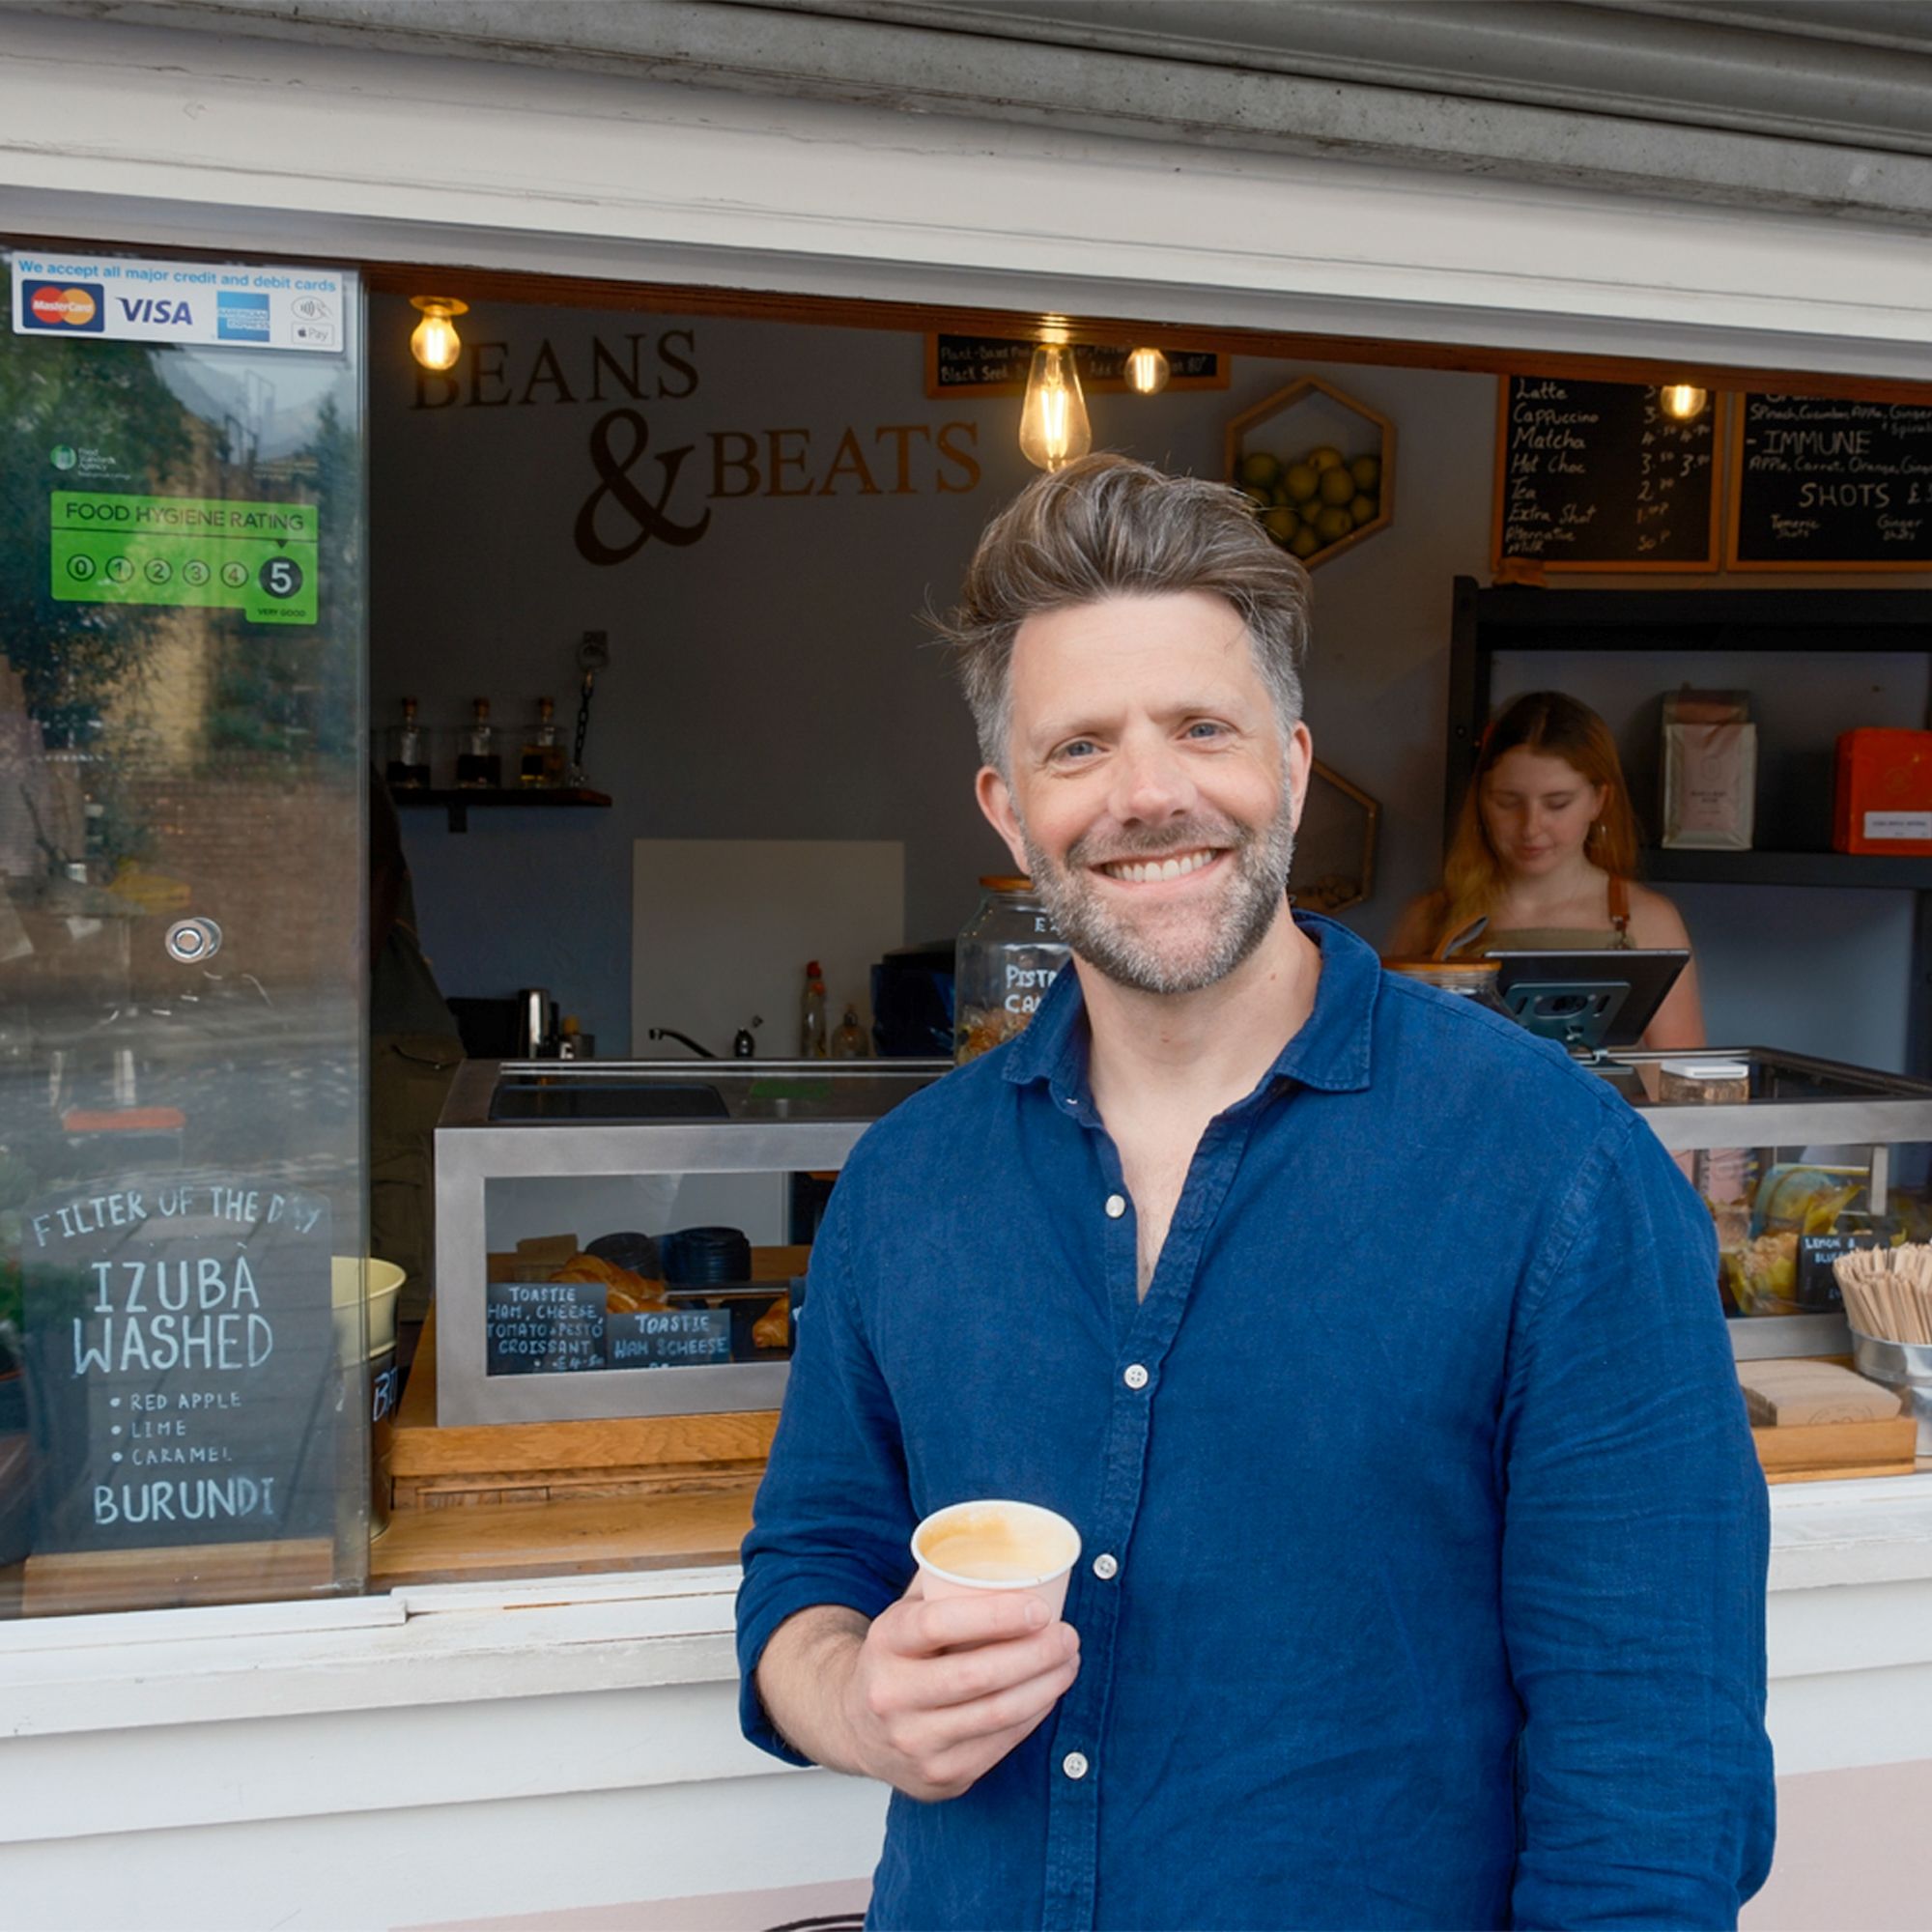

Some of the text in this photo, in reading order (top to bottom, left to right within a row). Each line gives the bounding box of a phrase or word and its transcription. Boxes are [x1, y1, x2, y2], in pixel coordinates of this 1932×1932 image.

[18, 260, 336, 292] We accept all major credit and debit cards
[33, 298, 193, 326] MasterCard VISA
[308, 326, 328, 339] Pay
[1516, 378, 1569, 400] Latte
[1512, 426, 1586, 449] Matcha
[1762, 430, 1872, 454] IMMUNE
[1511, 453, 1539, 473] Hot
[574, 408, 981, 566] & BEATS
[1512, 475, 1536, 499] Tea
[1799, 482, 1890, 508] SHOTS
[66, 502, 304, 530] FOOD HYGIENE RATING
[270, 562, 292, 594] 5
[31, 1189, 147, 1247] FILTER
[210, 1186, 258, 1223] THE
[268, 1195, 322, 1235] DY
[1804, 1237, 1841, 1249] LEMON
[508, 1287, 577, 1303] TOASTIE
[487, 1322, 547, 1338] TOMATO
[635, 1313, 710, 1334] TOASTIE
[73, 1314, 273, 1377] WASHED
[498, 1339, 591, 1354] CROISSANT
[614, 1337, 649, 1359] HAM
[129, 1391, 242, 1411] RED APPLE
[131, 1419, 186, 1438] LIME
[131, 1447, 233, 1466] CARAMEL
[95, 1476, 274, 1524] BURUNDI
